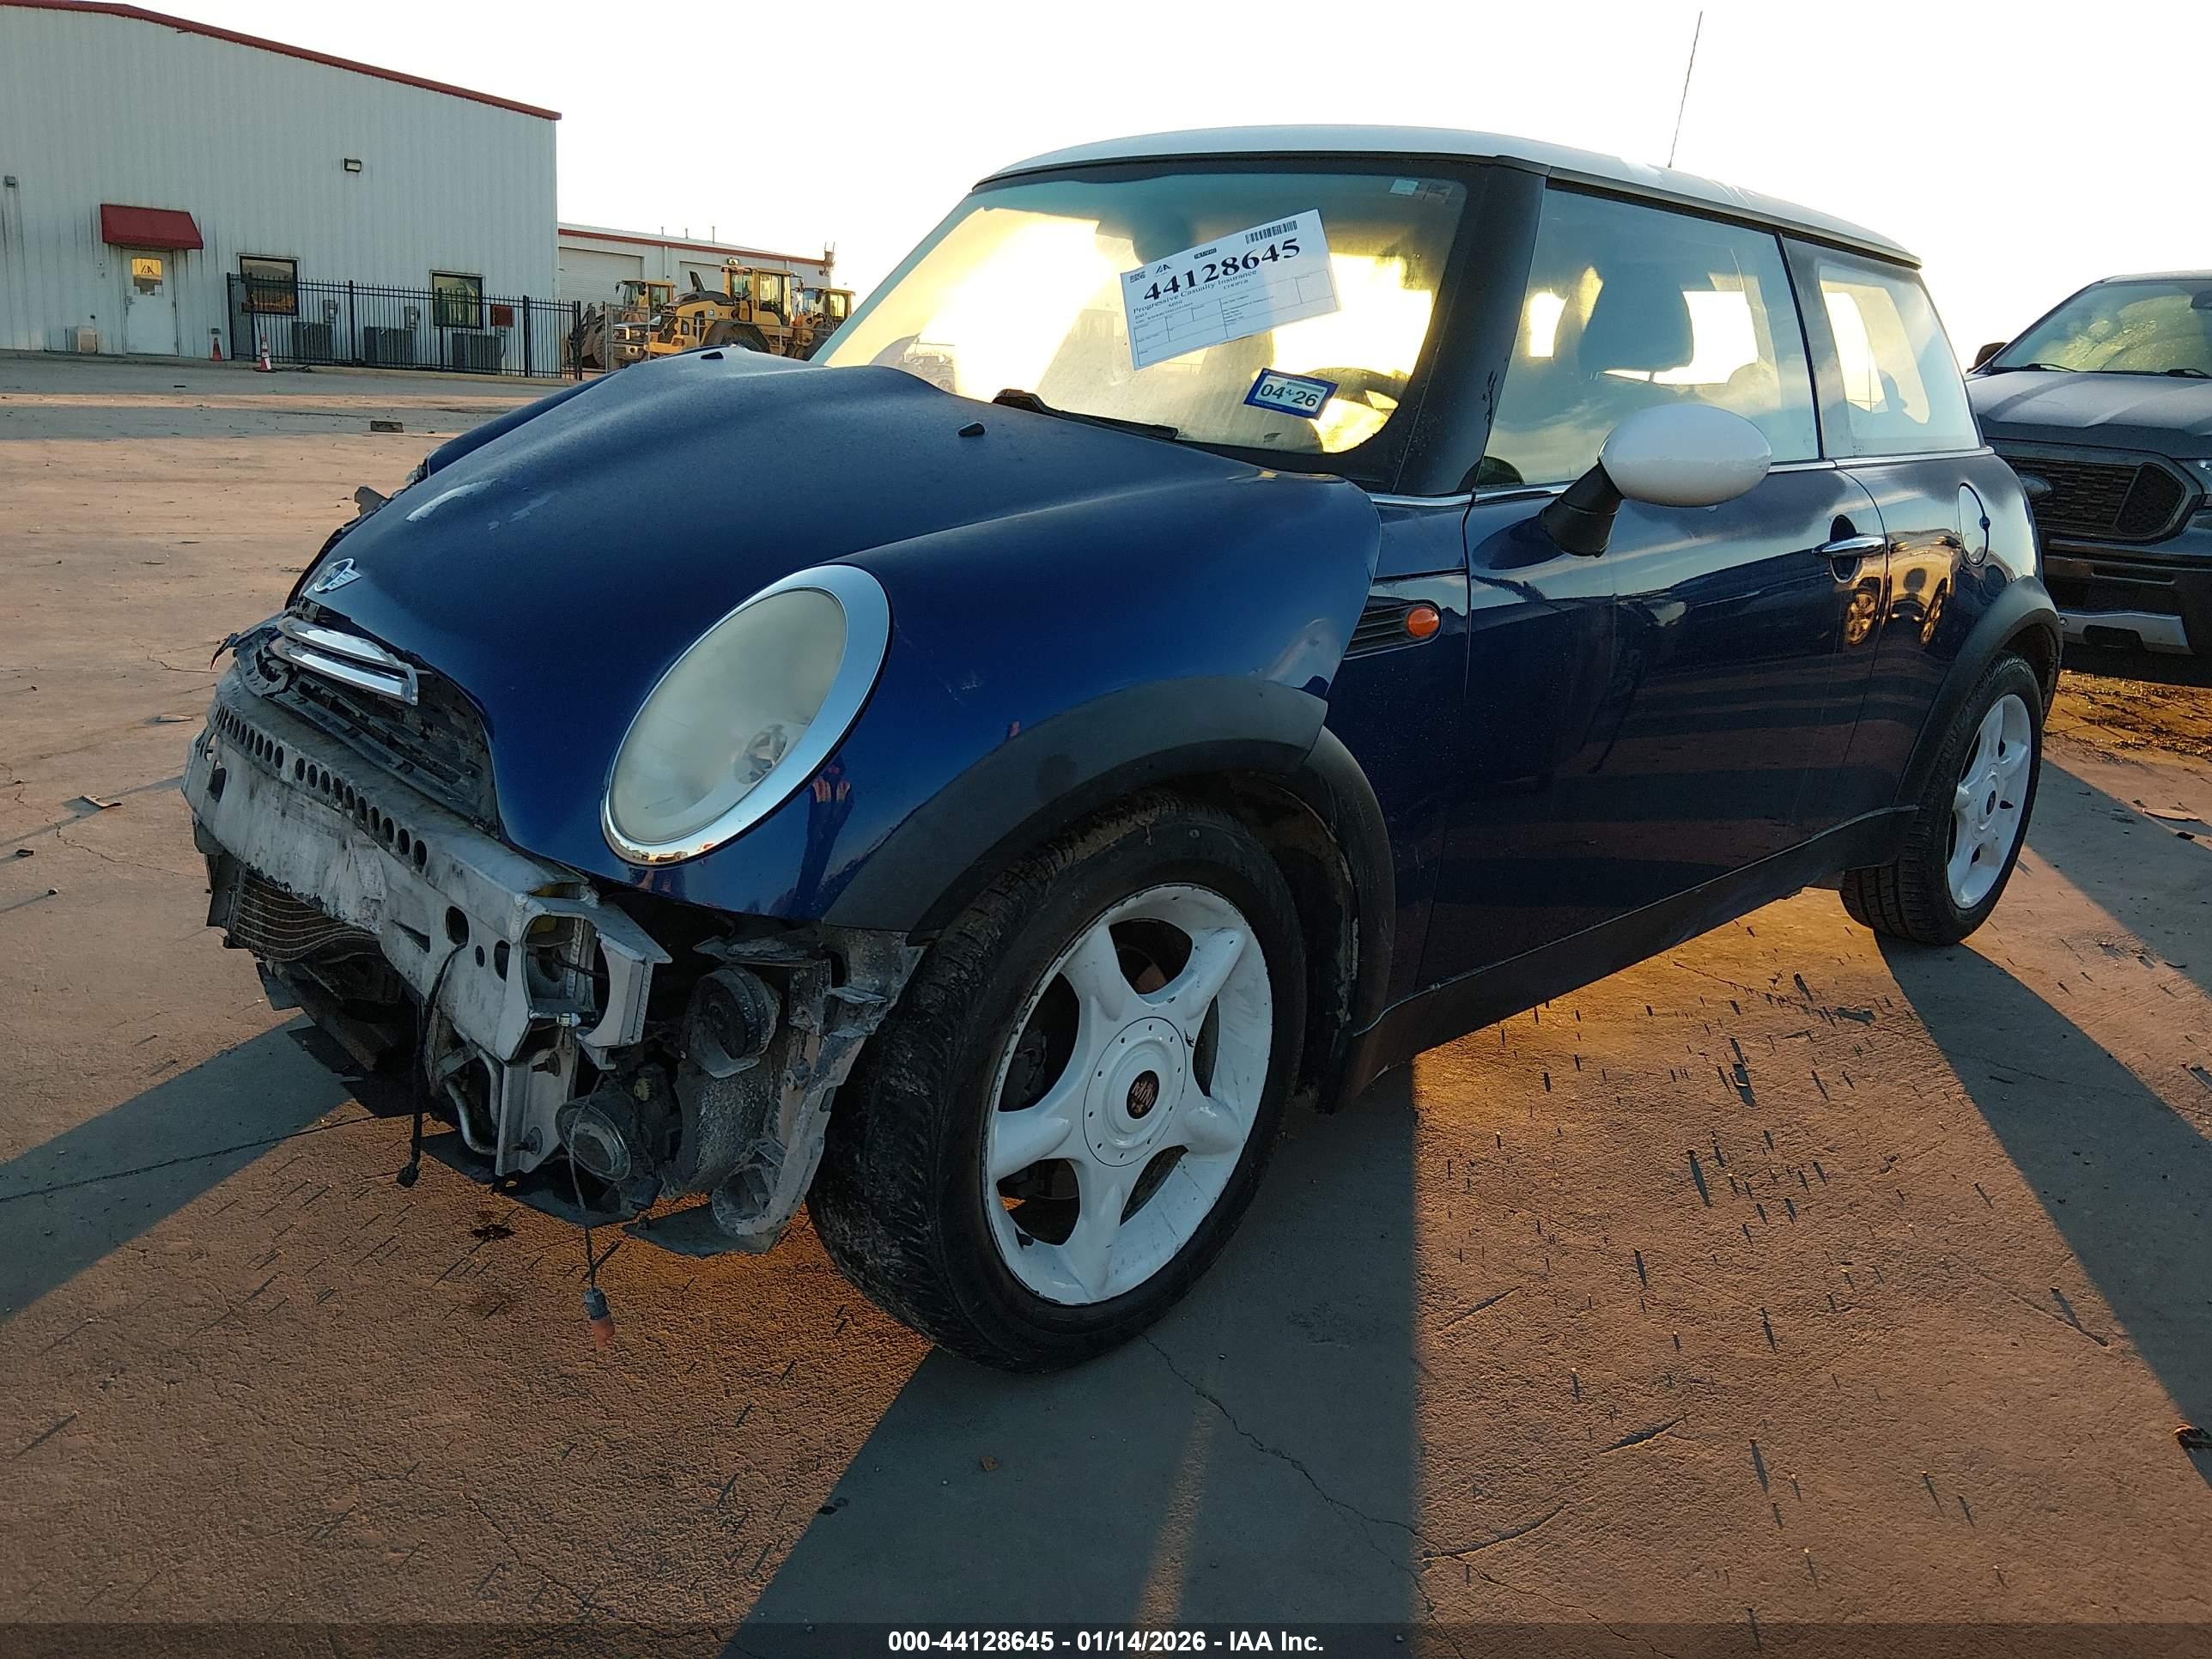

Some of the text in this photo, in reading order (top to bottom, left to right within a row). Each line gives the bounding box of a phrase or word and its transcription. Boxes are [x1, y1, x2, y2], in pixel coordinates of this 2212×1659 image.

[1144, 238, 1301, 301] 44128645
[1133, 295, 1179, 314] Progressive
[1181, 283, 1216, 297] Casualty
[1218, 270, 1257, 285] Insurance
[1260, 384, 1285, 399] 04
[1291, 391, 1320, 407] 26
